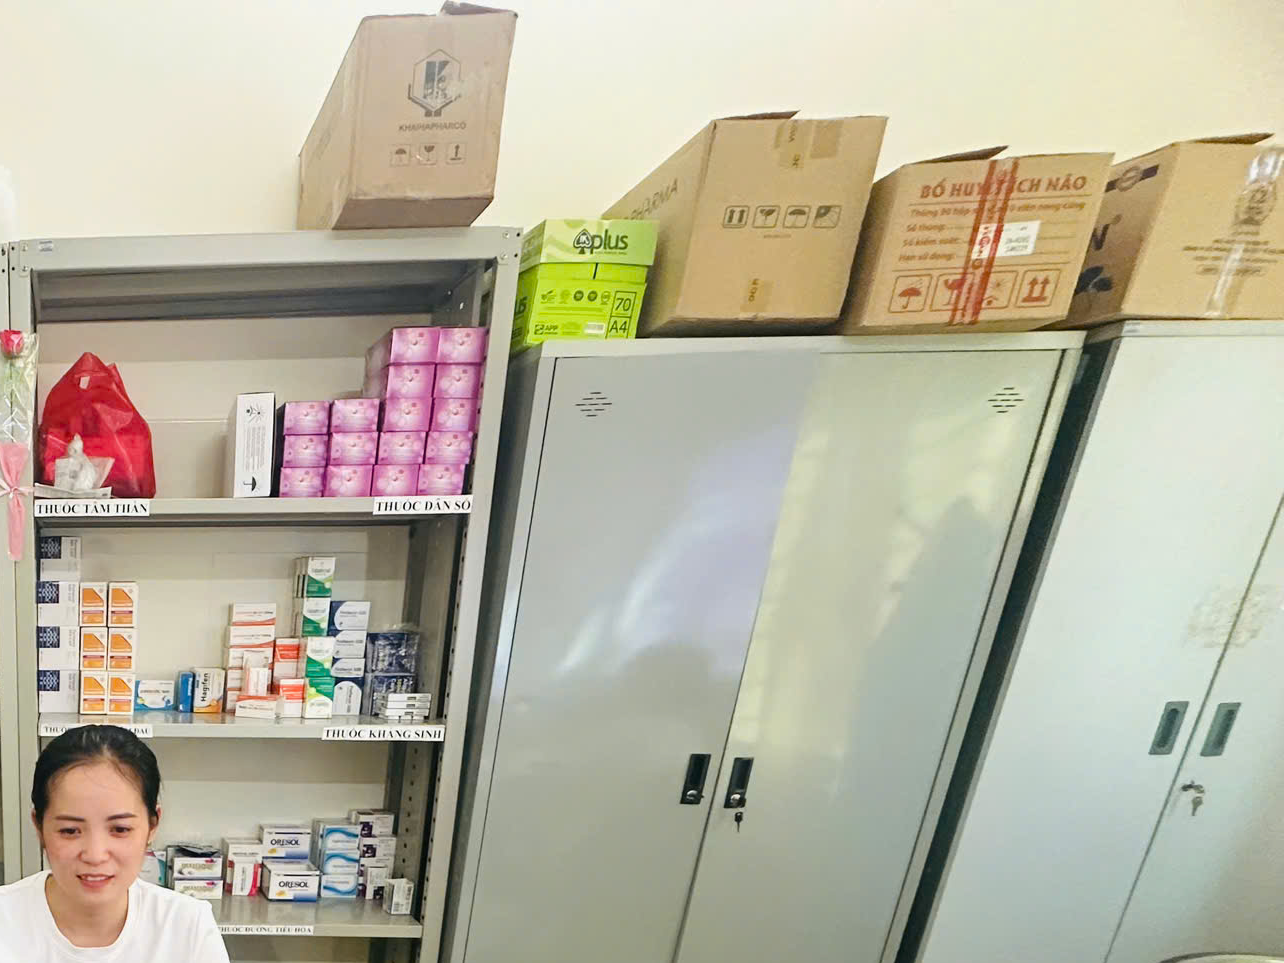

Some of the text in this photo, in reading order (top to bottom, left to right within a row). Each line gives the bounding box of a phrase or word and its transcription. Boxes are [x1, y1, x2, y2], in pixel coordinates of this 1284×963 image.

[615, 298, 632, 312] 70
[609, 320, 627, 334] A4
[200, 673, 210, 702] Hagifen
[415, 729, 442, 739] SINH
